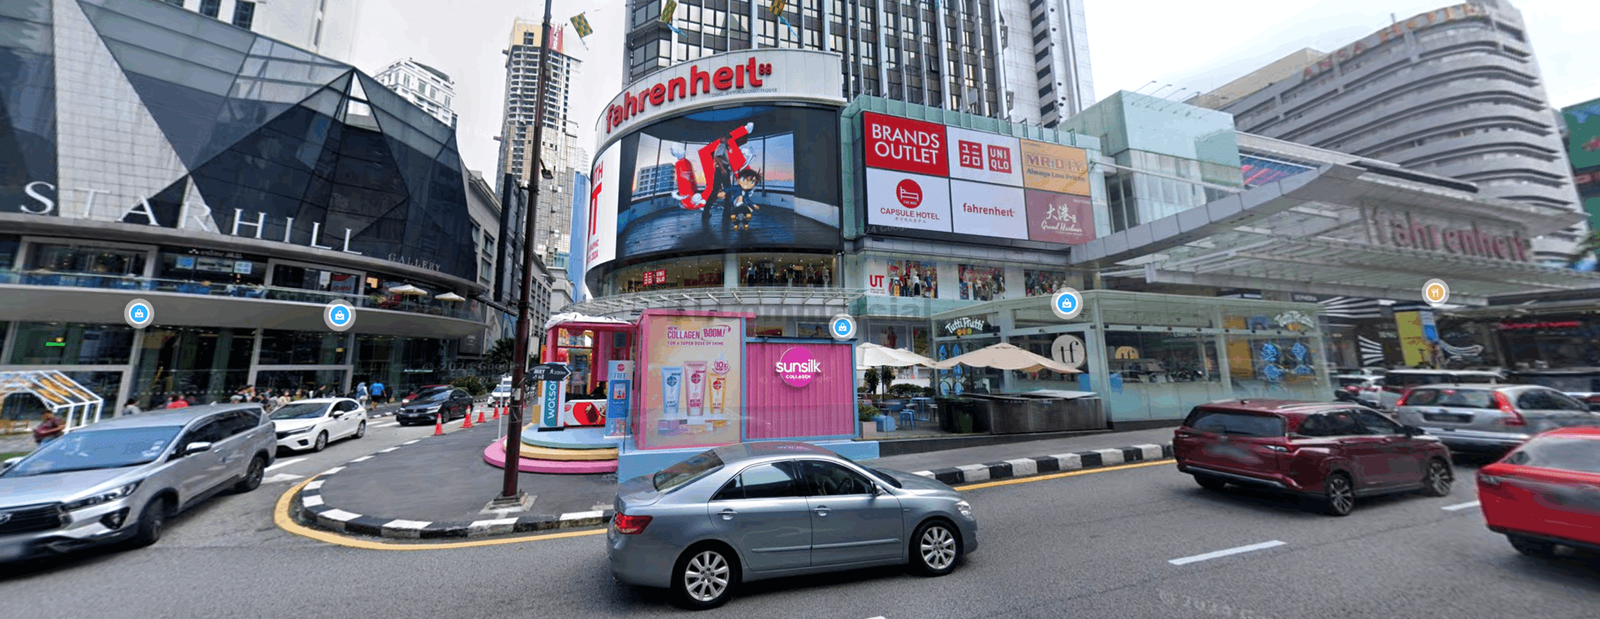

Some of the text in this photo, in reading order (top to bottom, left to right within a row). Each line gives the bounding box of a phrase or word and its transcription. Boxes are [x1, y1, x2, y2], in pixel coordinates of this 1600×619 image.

[605, 57, 772, 134] fahrenheit 88
[872, 124, 940, 149] BRANDS
[875, 141, 939, 164] OUTLET
[990, 148, 1008, 160] UNI
[991, 159, 1010, 171] QLO
[1026, 168, 1051, 178] Always
[880, 208, 940, 220] CAPSULE HOTEL
[963, 203, 1013, 218] fahrenheit
[1046, 204, 1072, 222] 大港
[20, 181, 362, 256] STARHILL
[1041, 219, 1059, 231] Grand
[388, 252, 443, 272] GALLERY
[869, 275, 884, 288] UT
[945, 317, 985, 333] Tutti Frutti
[667, 328, 726, 339] COLLAGEN BOOM!
[1060, 340, 1079, 363] tf
[775, 359, 821, 373] sunsilk
